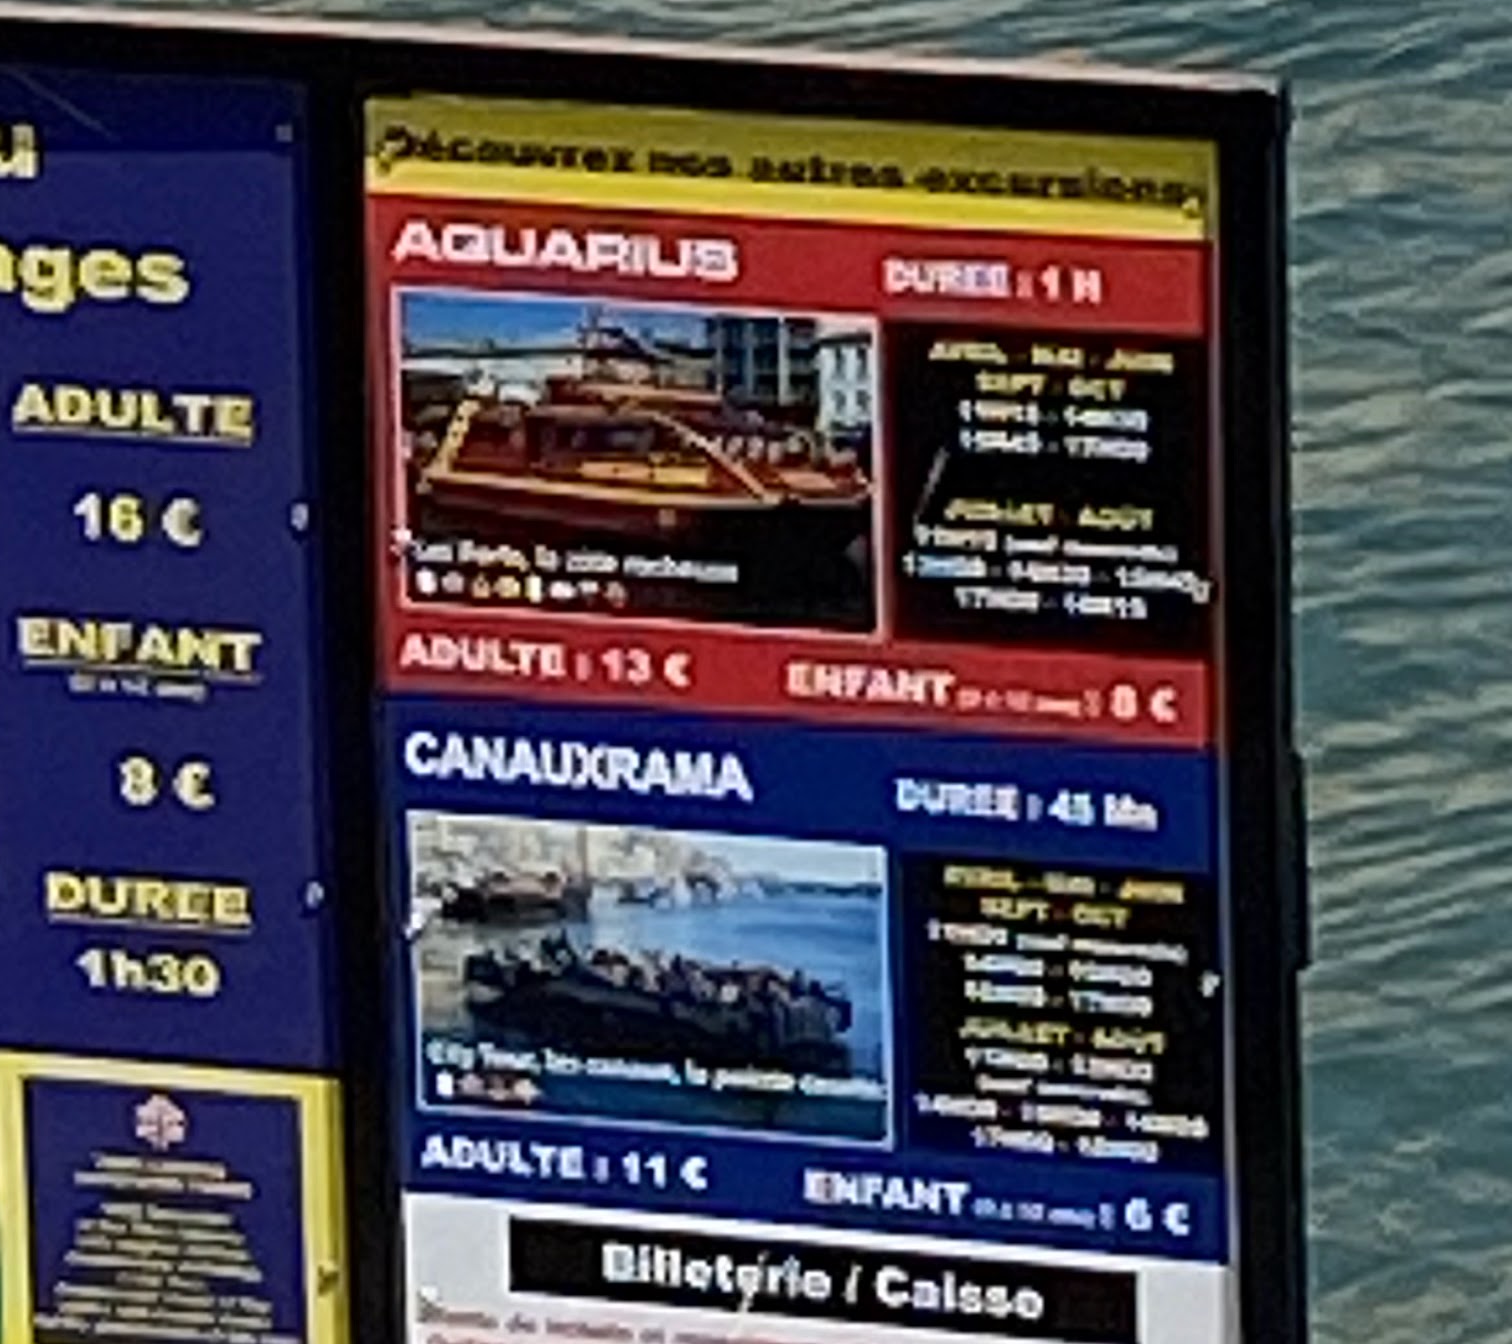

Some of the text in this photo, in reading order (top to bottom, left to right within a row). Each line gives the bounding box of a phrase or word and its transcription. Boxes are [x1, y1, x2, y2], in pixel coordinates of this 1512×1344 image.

[751, 153, 905, 189] autres
[392, 217, 740, 283] AQUARIUS
[1039, 265, 1061, 302] 1
[12, 382, 255, 441] ADULTE
[72, 492, 145, 543] 16
[16, 615, 263, 673] ENFANT
[399, 632, 567, 678] ADULTE
[601, 648, 652, 685] 13
[787, 661, 957, 708] ENFANT
[117, 756, 158, 808] 8
[403, 730, 754, 802] CANAUXRAMA
[45, 869, 253, 924] DUREE
[75, 947, 221, 999] 1h30
[420, 1134, 585, 1180] ADULTE
[621, 1151, 669, 1190] 11
[803, 1166, 971, 1217] ENFANT
[873, 1265, 1044, 1321] Caisse
